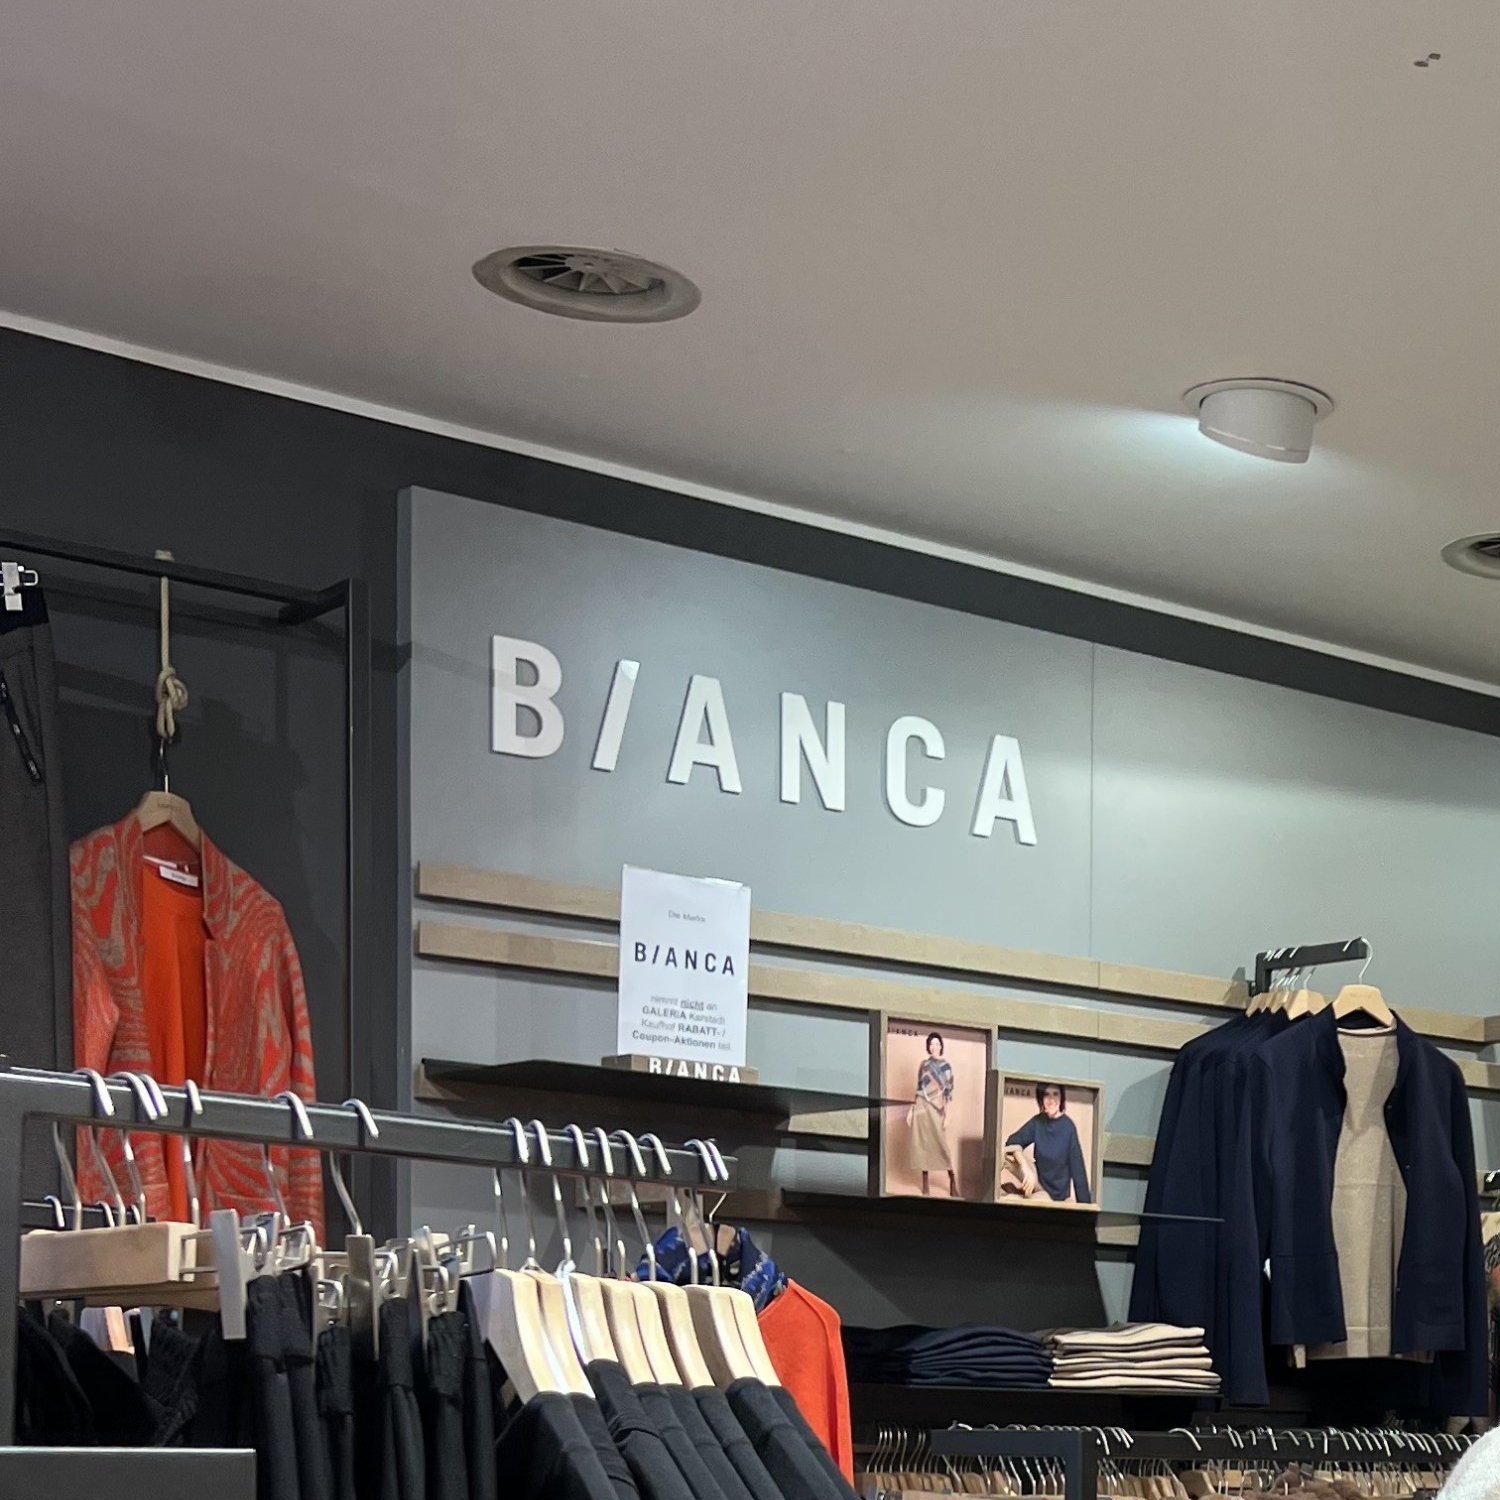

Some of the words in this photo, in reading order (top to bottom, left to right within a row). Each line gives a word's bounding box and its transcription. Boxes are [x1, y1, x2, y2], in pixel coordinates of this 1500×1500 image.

[680, 999, 704, 1011] nicht
[706, 1002, 718, 1011] an
[642, 1005, 687, 1020] GALERIA
[689, 1012, 726, 1025] Karstadt
